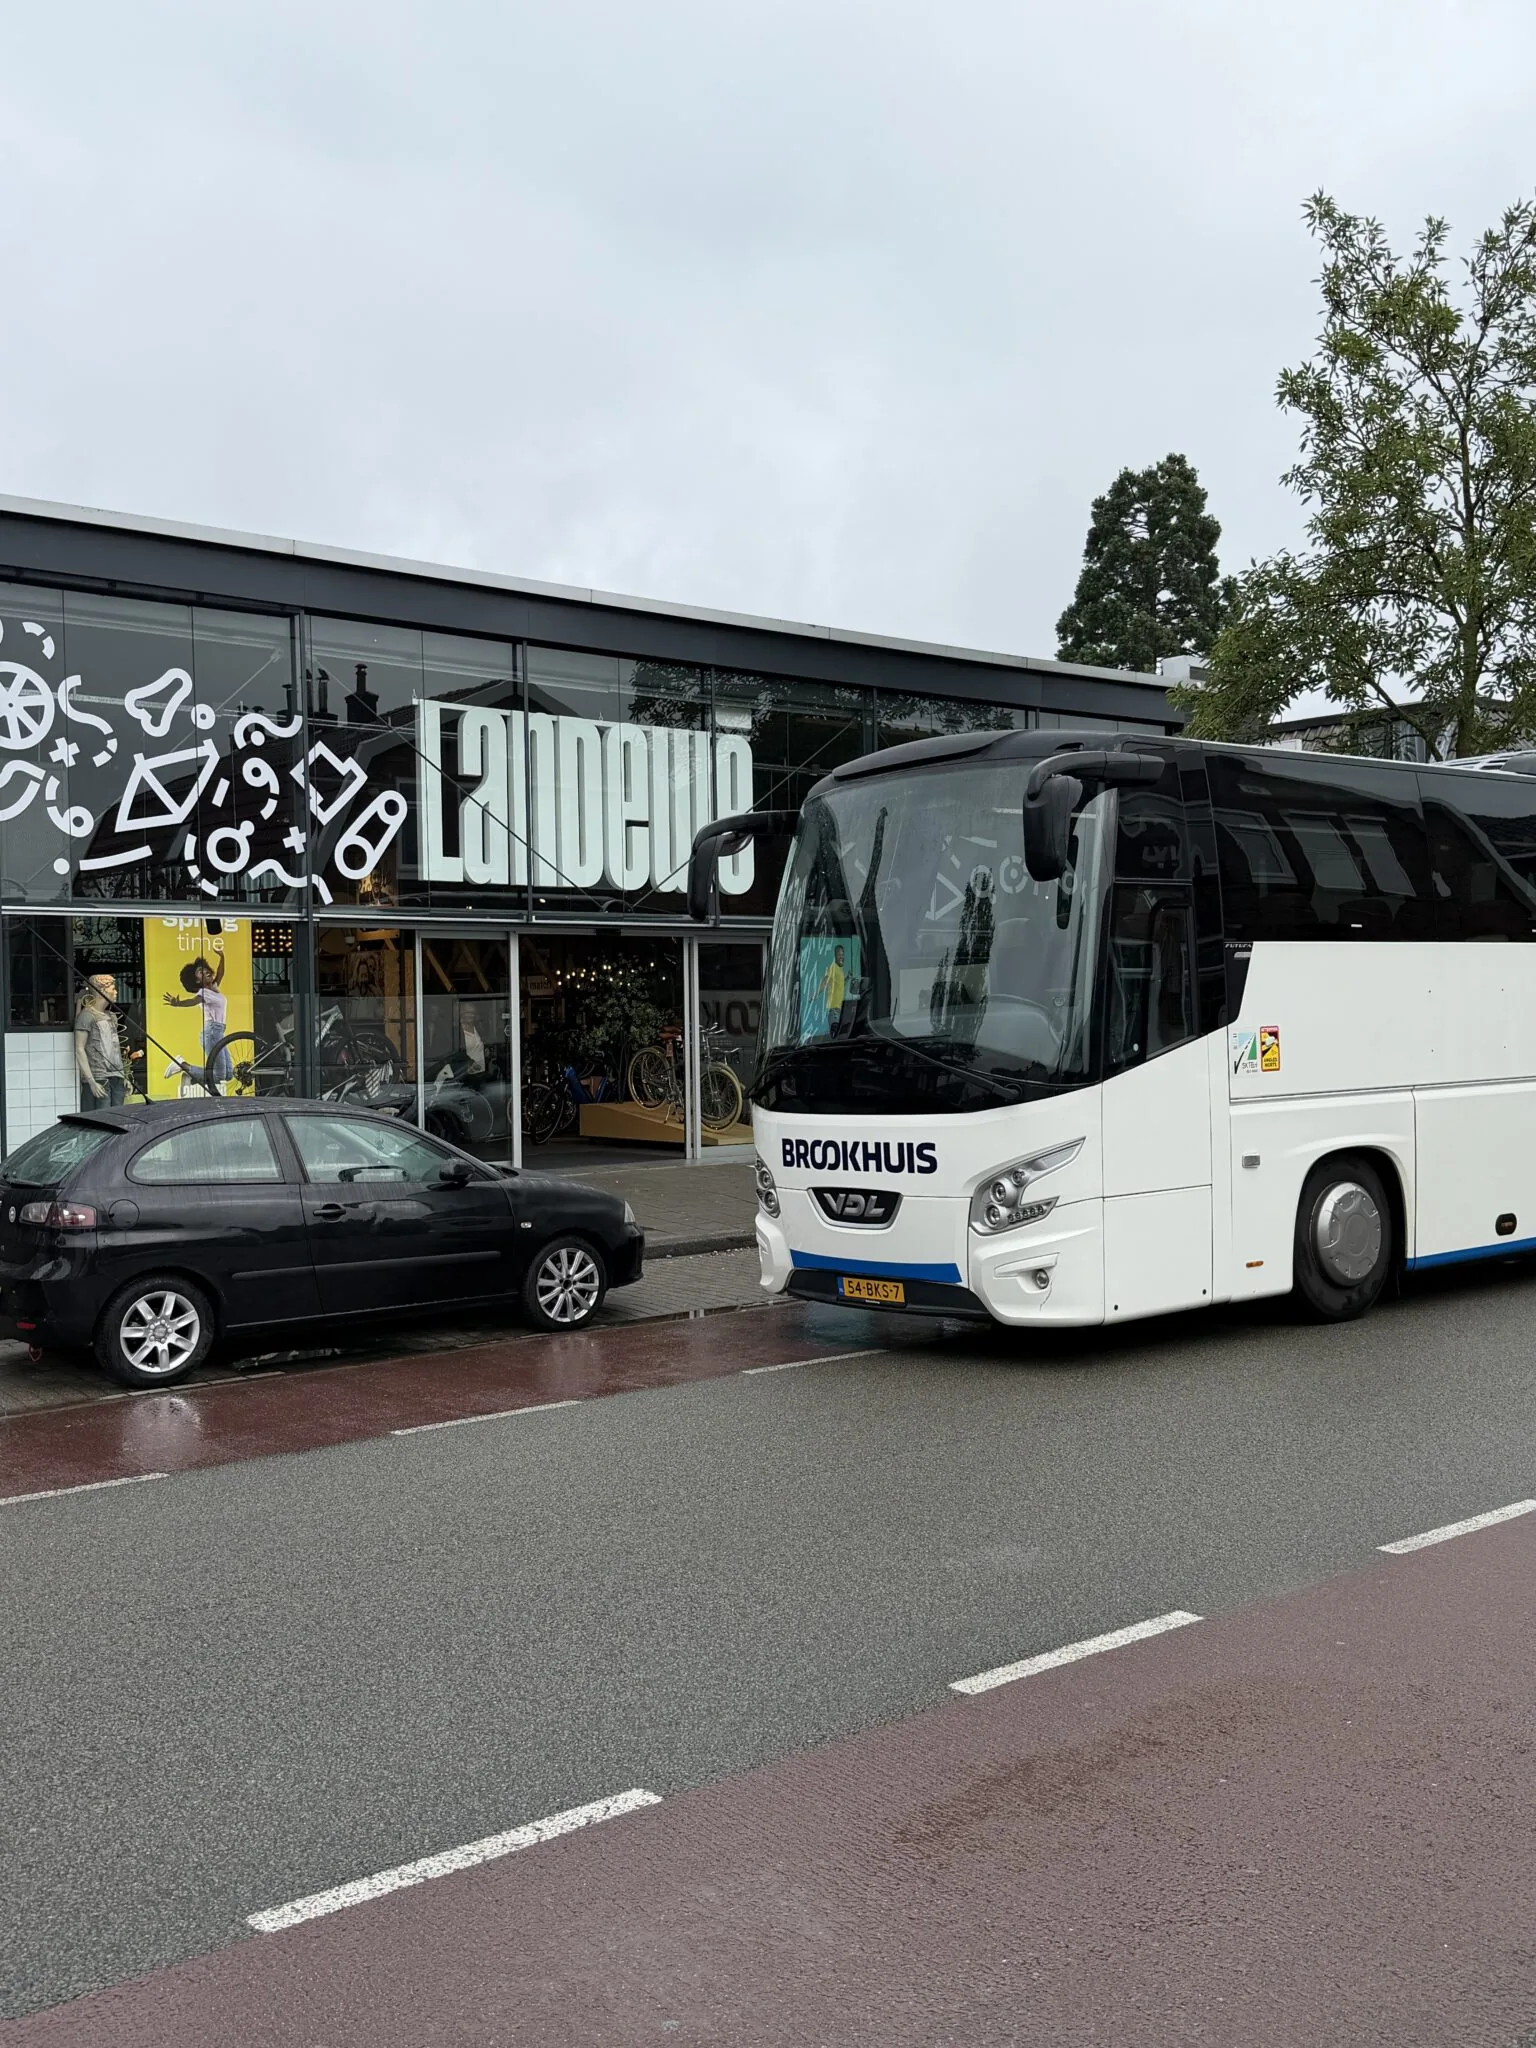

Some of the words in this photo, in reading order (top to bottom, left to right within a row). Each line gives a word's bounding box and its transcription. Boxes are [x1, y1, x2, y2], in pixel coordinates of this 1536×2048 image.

[176, 933, 224, 951] time
[782, 1138, 938, 1174] BROOKHUIS
[824, 1192, 886, 1218] VDL
[847, 1280, 900, 1300] 54-BKS-7
